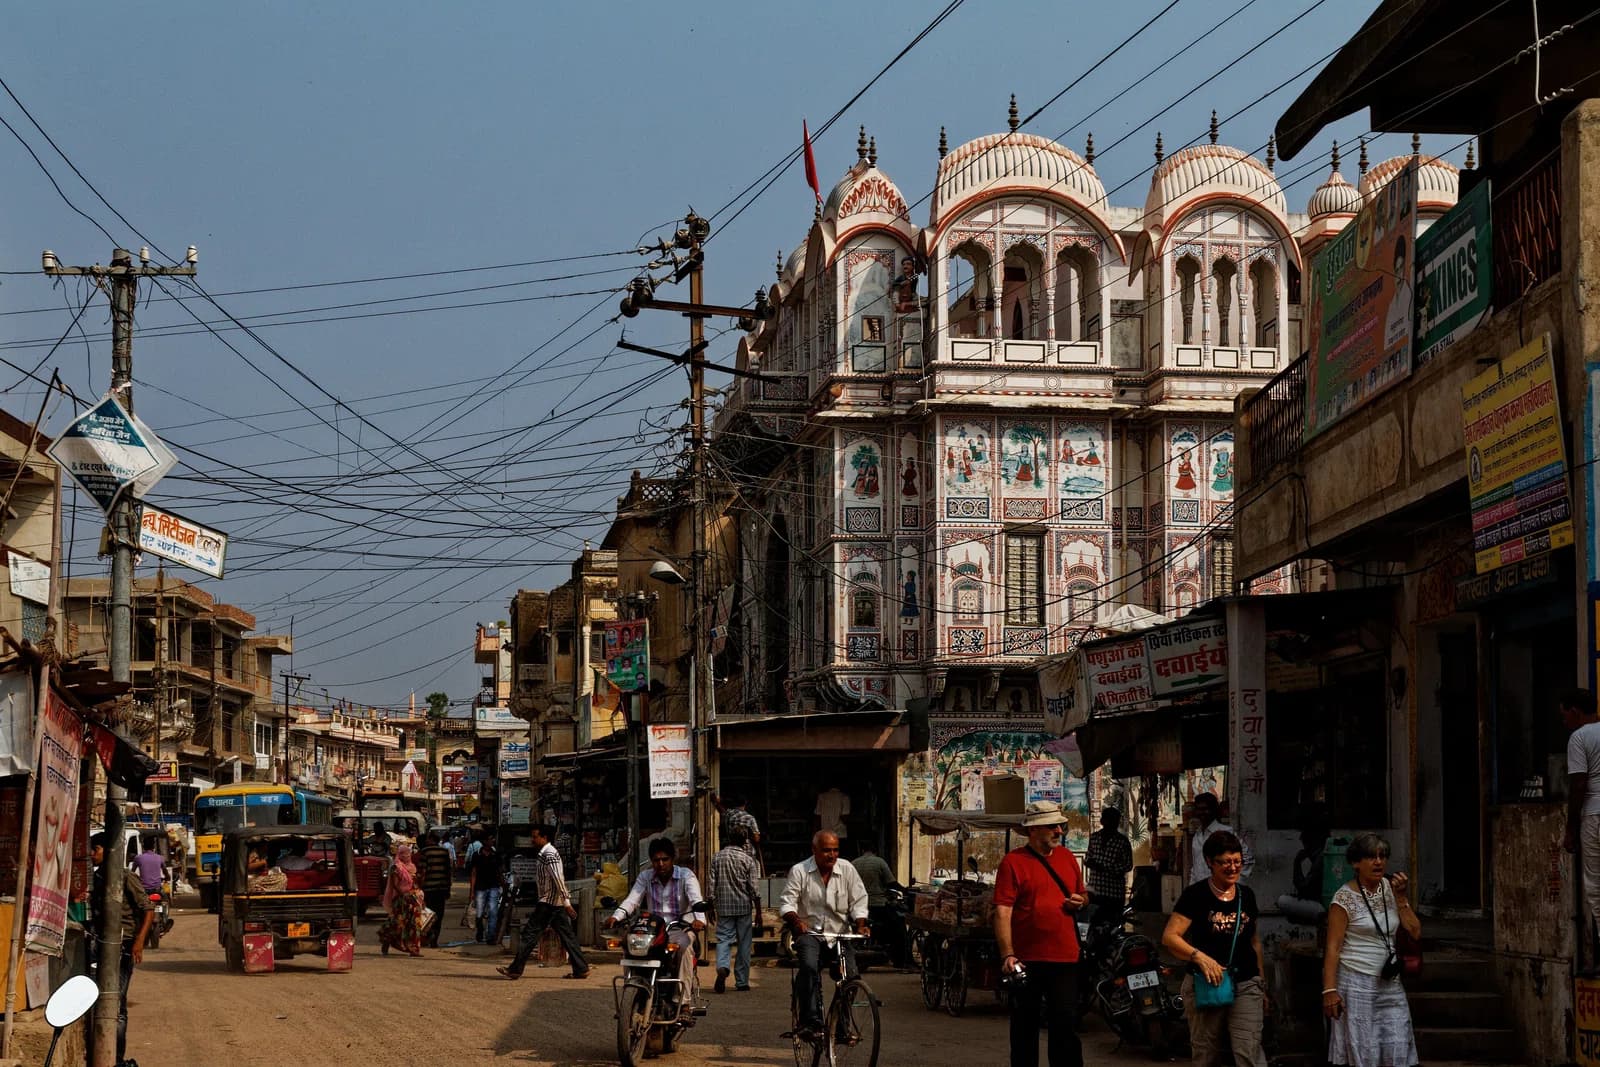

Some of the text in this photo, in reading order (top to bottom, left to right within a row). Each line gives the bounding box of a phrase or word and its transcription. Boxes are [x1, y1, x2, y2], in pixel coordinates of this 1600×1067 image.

[1431, 238, 1478, 316] KINGS
[1440, 333, 1455, 351] STALL
[142, 512, 157, 533] न्यू
[158, 514, 197, 547] सिटीजन
[1173, 625, 1211, 644] मेडिकल
[1128, 638, 1144, 658] की
[1106, 687, 1138, 706] मिलती
